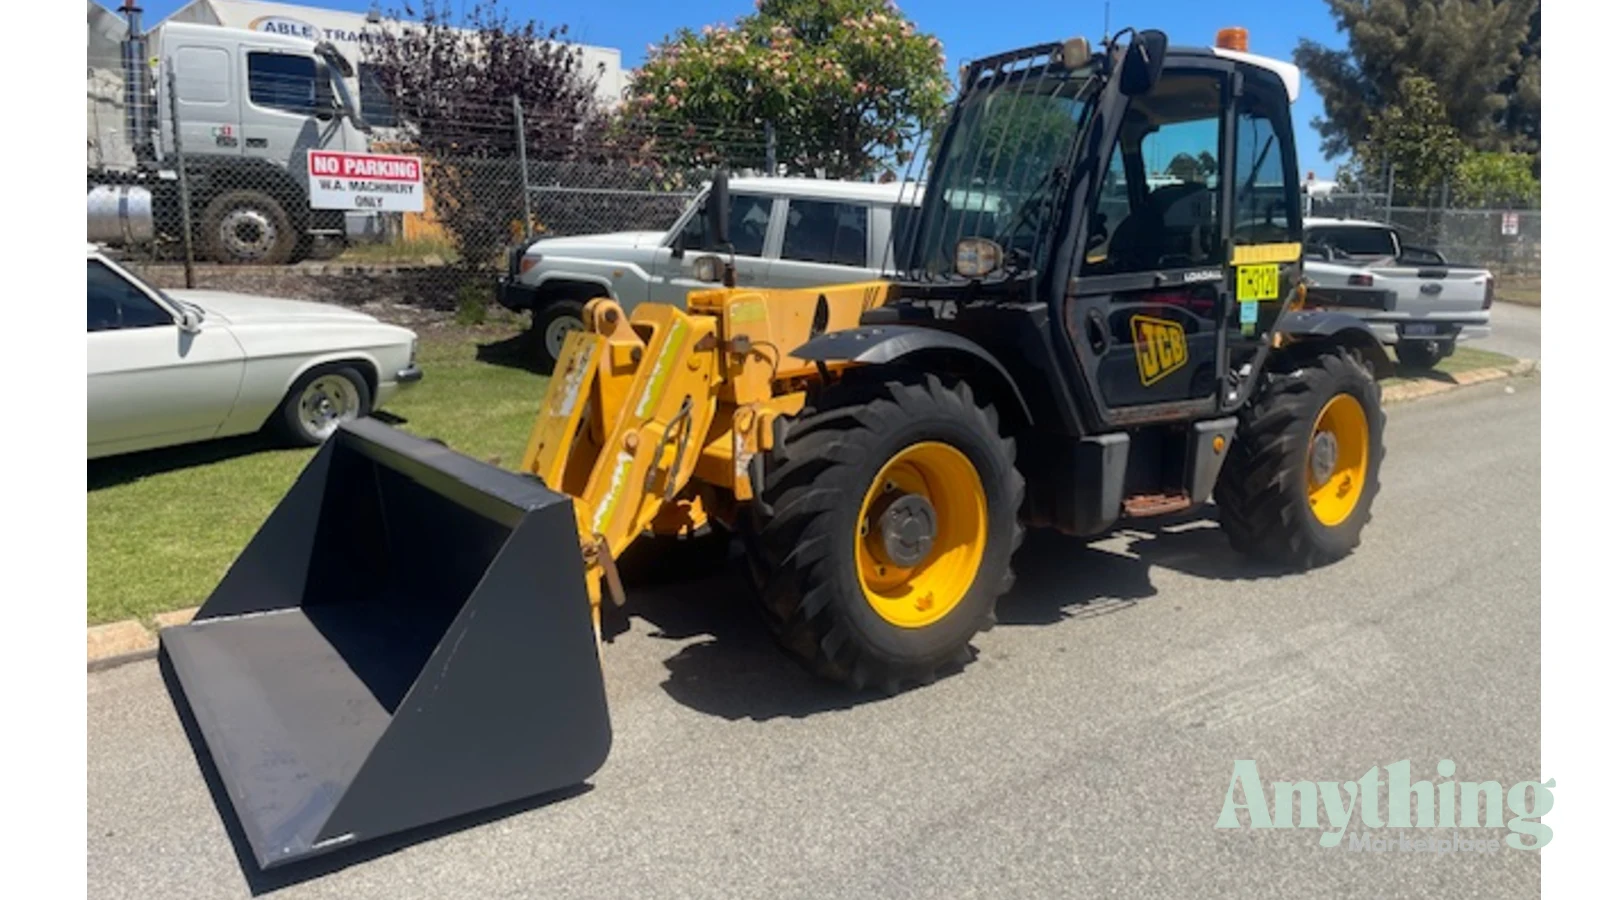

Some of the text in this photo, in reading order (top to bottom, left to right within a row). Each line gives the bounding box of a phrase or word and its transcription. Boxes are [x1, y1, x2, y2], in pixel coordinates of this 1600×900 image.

[264, 21, 313, 38] ABLE
[313, 156, 417, 179] NO PARKING
[319, 180, 414, 194] W.A. MACHINERY
[354, 195, 384, 207] ONLY
[1139, 322, 1184, 378] JCB
